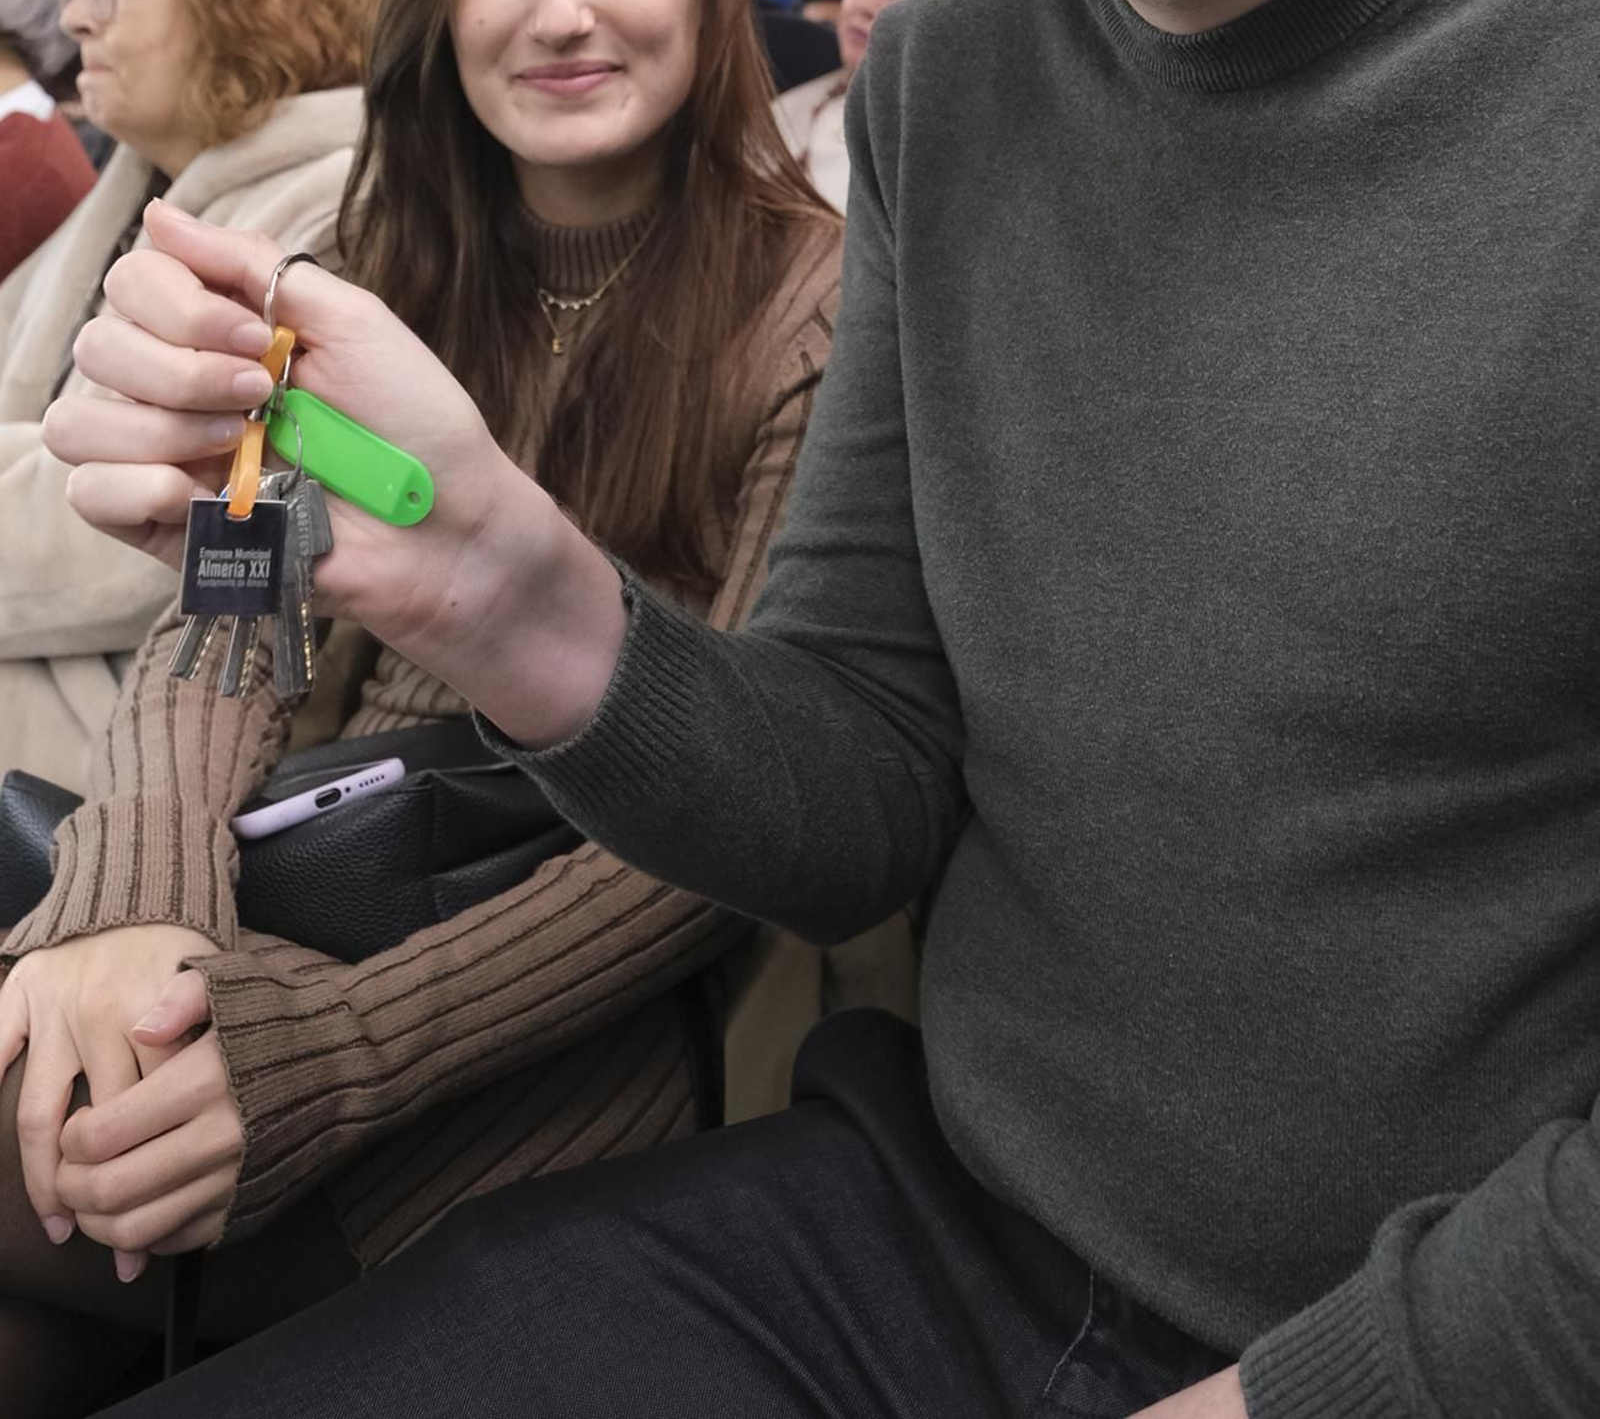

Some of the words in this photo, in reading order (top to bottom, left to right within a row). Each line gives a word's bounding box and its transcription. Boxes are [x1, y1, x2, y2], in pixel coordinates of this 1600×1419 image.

[199, 547, 233, 560] Empresa
[234, 548, 272, 560] Municipal
[197, 560, 245, 577] Almería
[249, 560, 271, 578] XXI
